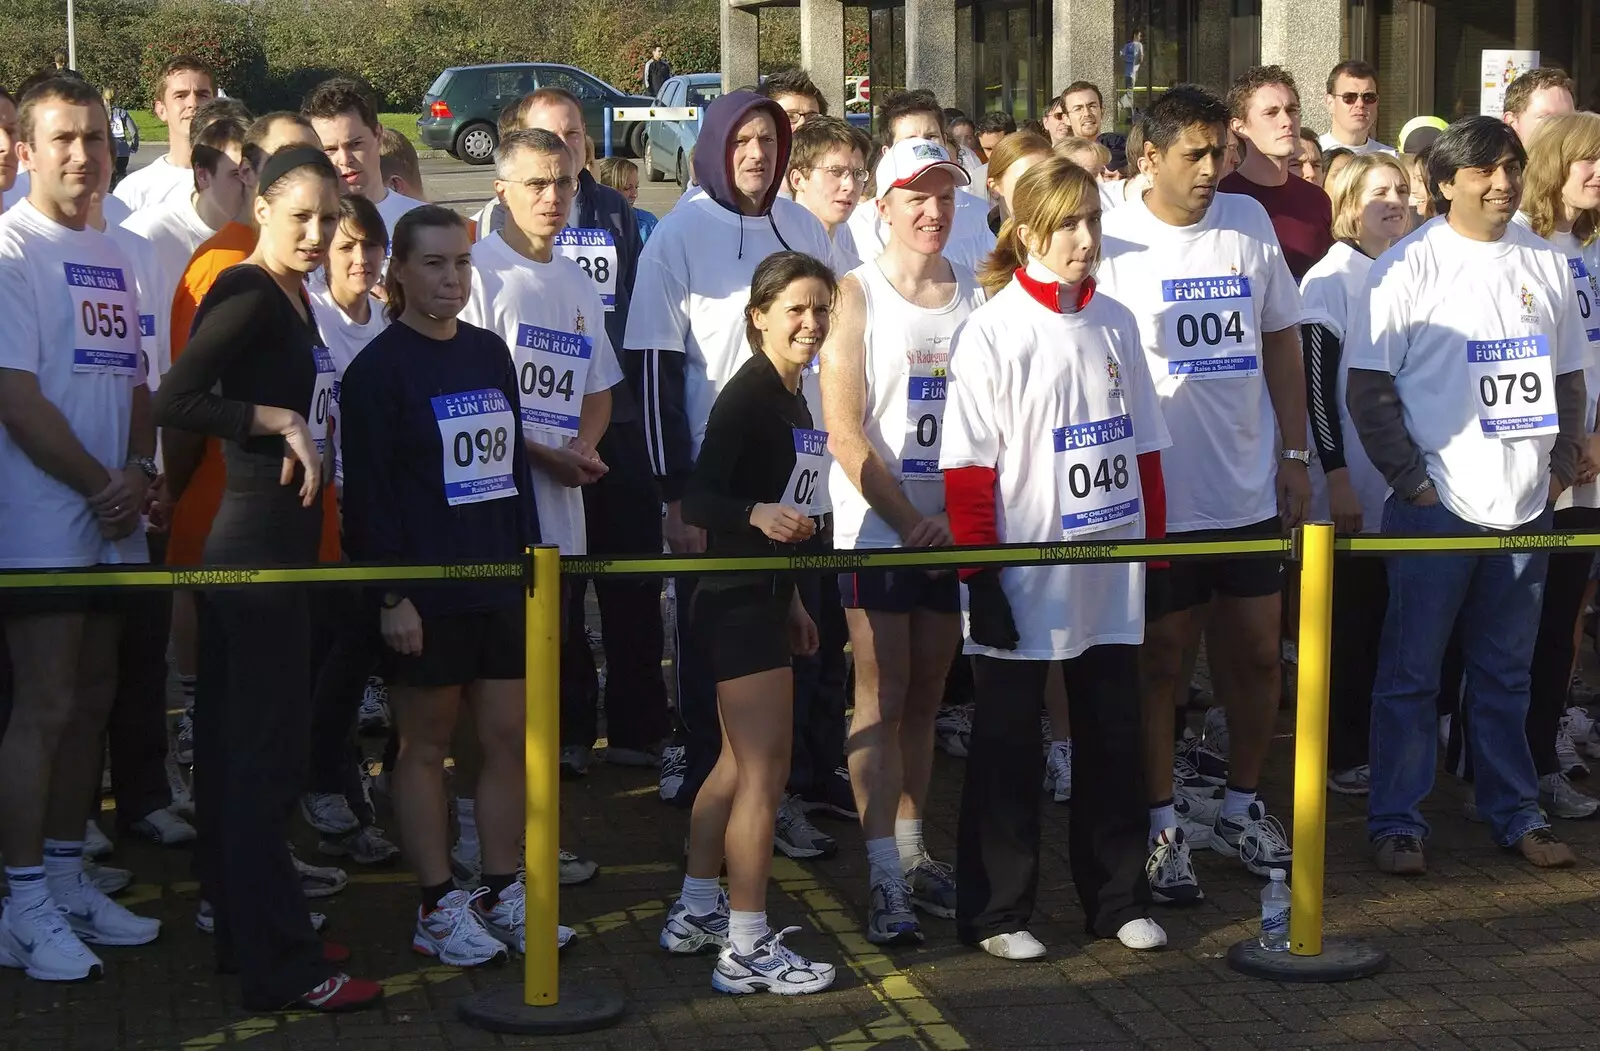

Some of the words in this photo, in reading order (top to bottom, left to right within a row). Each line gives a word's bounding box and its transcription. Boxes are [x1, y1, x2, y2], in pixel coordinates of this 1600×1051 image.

[554, 235, 579, 245] FUN
[581, 236, 606, 246] RUN
[71, 267, 116, 278] CAMBRIDGE
[72, 274, 97, 286] FUN
[97, 277, 120, 289] RUN
[1175, 279, 1240, 288] CAMBRIDGE
[1175, 288, 1206, 300] FUN
[1211, 285, 1241, 298] RUN
[82, 300, 127, 339] 055
[527, 329, 581, 344] CAMBRIDGE
[1177, 311, 1245, 347] 004
[526, 335, 549, 350] FUN
[552, 341, 580, 356] RUN
[1476, 340, 1537, 349] CAMBRIDGE
[906, 350, 915, 364] St
[1476, 350, 1502, 361] FUN
[1506, 346, 1538, 360] RUN
[520, 361, 575, 402] 094
[921, 387, 946, 399] FUN
[1480, 372, 1542, 407] 079
[445, 393, 503, 405] CAMBRIDGE
[447, 402, 479, 417] FUN
[482, 399, 505, 413] RUN
[916, 414, 943, 447] 0
[1065, 420, 1124, 436] CAMBRIDGE
[1516, 422, 1534, 430] Smile!
[1065, 433, 1097, 449] FUN
[1101, 426, 1125, 442] RUN
[454, 427, 508, 467] 098
[1068, 454, 1129, 499] 048
[471, 486, 486, 494] Raise
[1089, 506, 1114, 518] CHILDREN
[1109, 511, 1124, 520] Smile!
